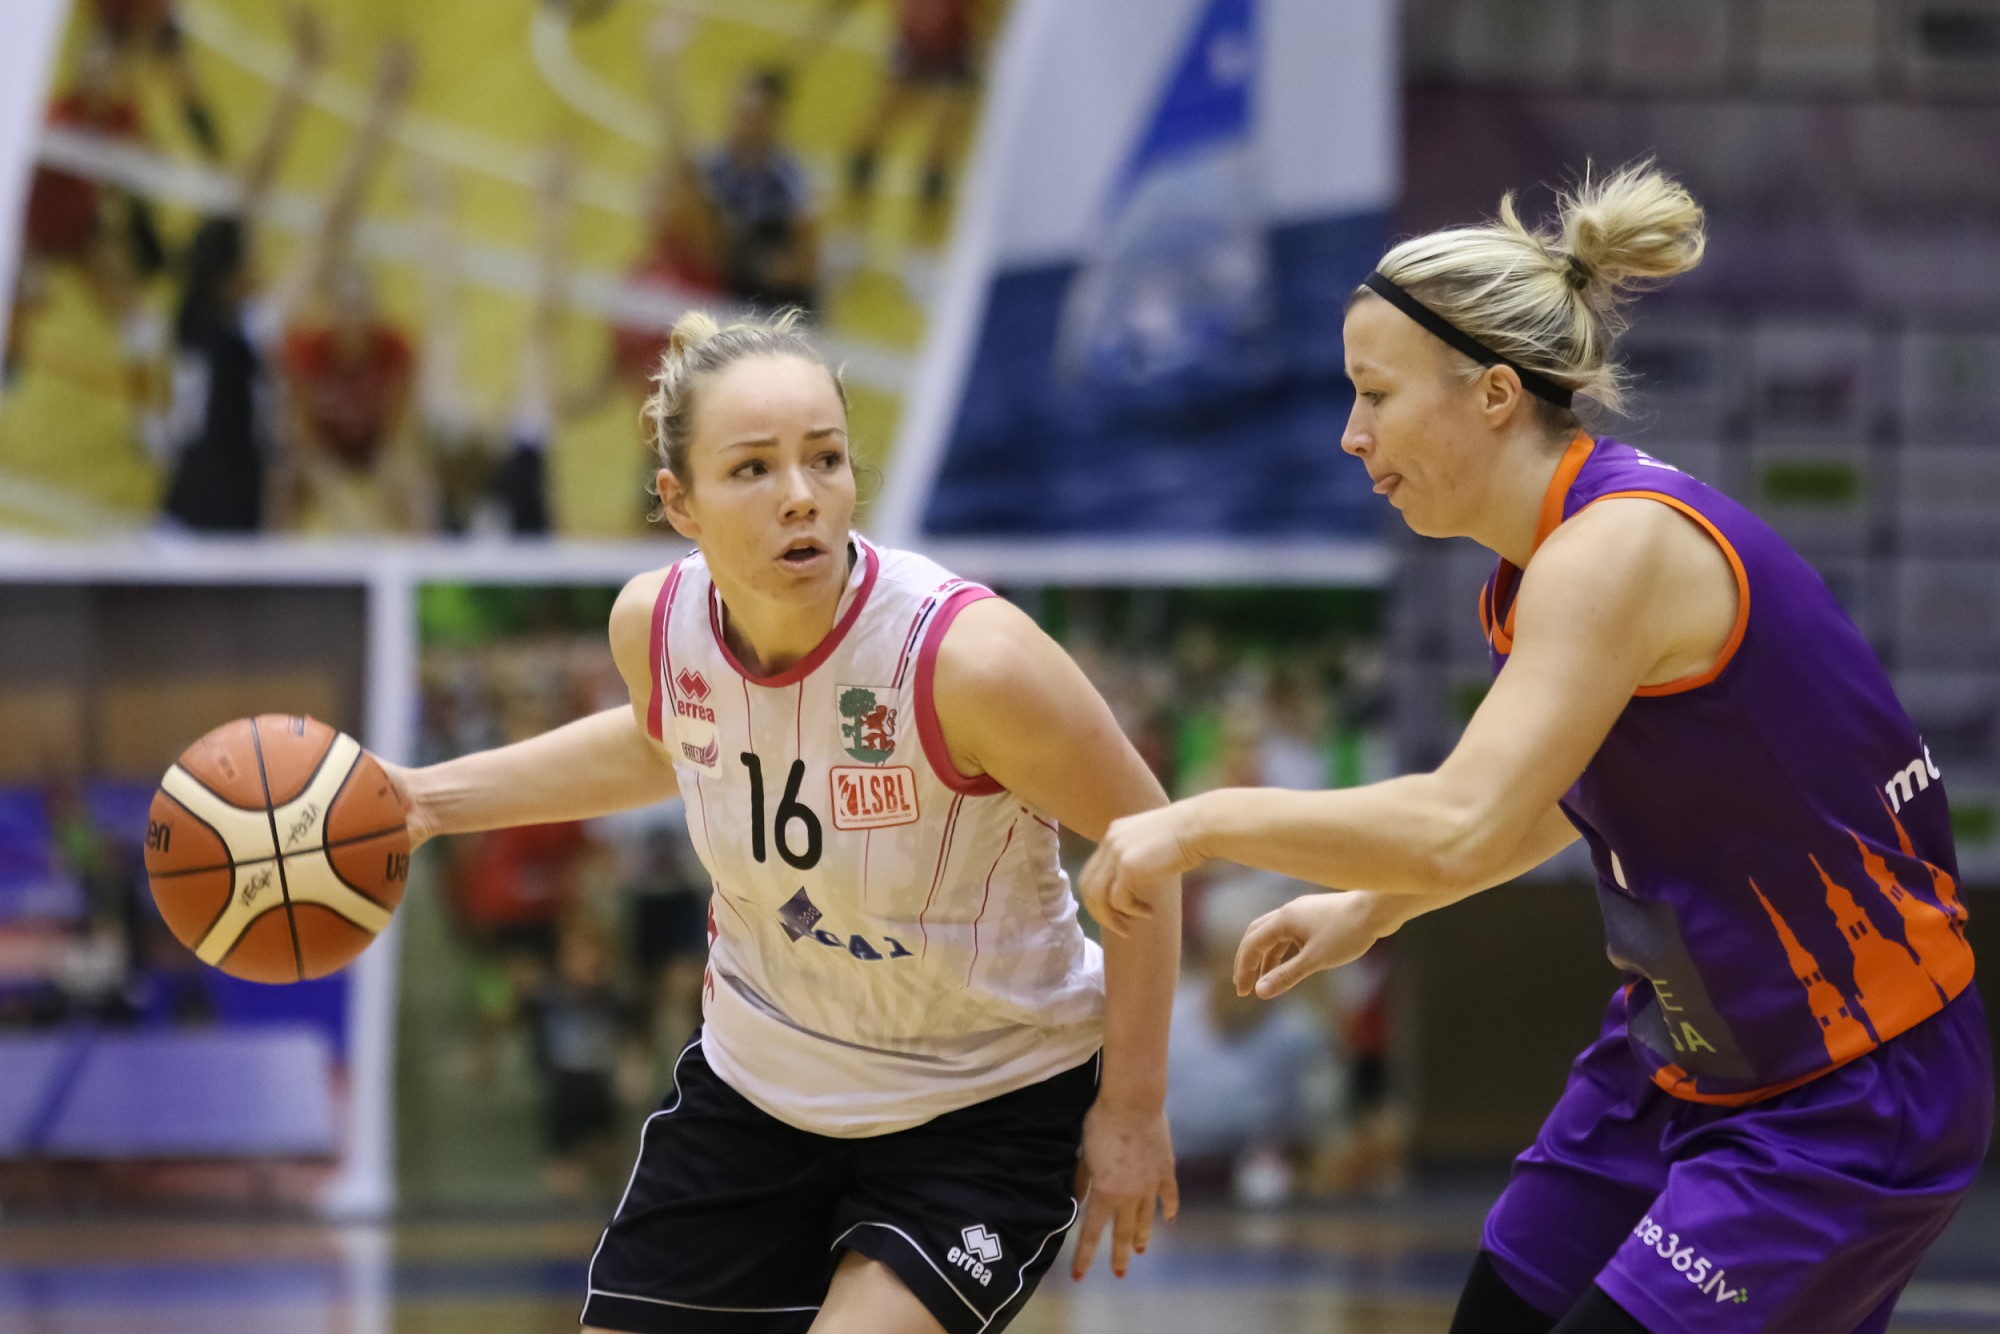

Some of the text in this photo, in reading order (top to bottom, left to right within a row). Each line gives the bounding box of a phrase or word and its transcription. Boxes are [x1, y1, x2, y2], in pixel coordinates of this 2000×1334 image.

[677, 700, 715, 724] errea
[740, 751, 823, 871] 16
[859, 774, 911, 815] LSBL
[947, 1246, 993, 1287] errea
